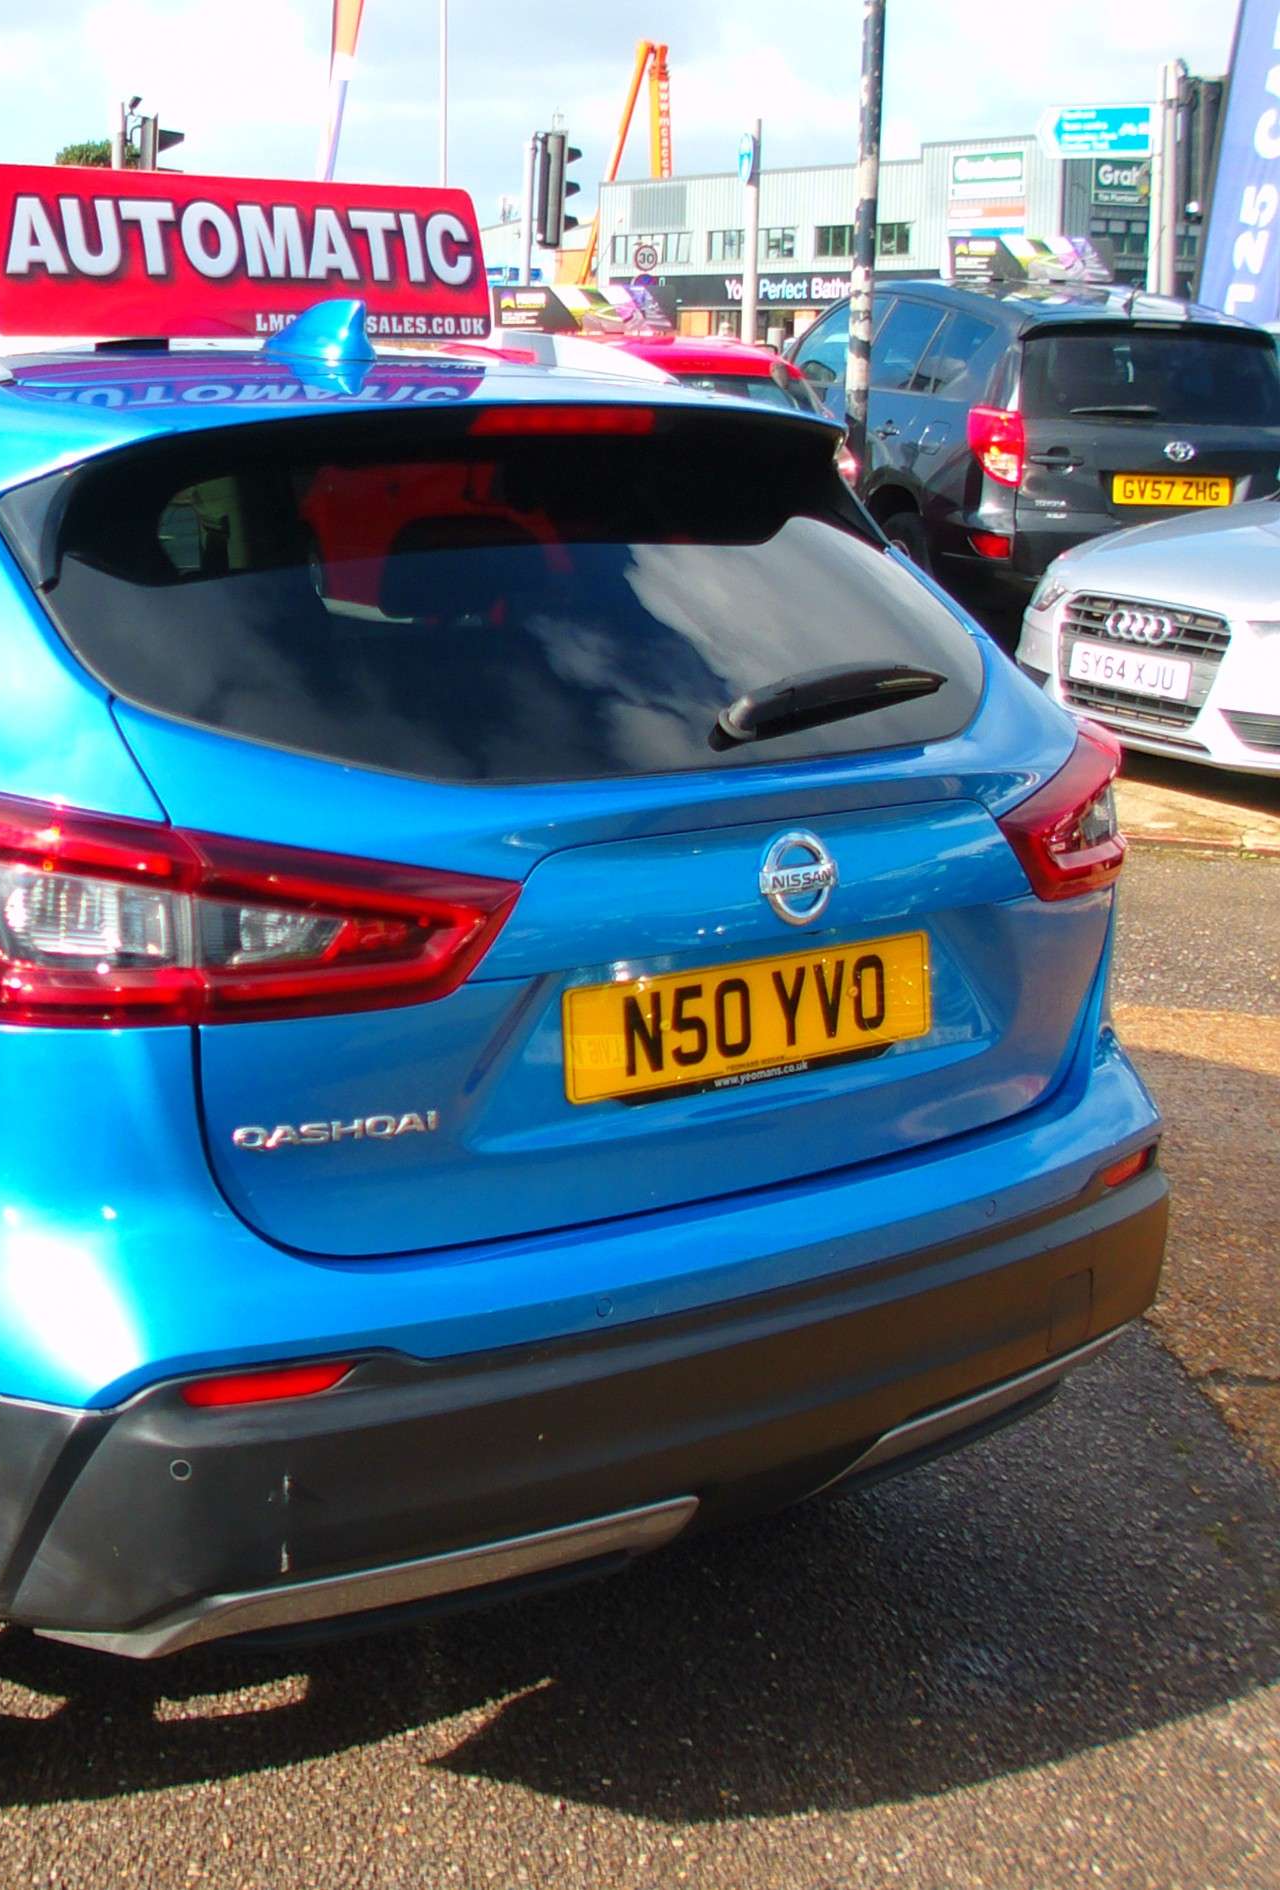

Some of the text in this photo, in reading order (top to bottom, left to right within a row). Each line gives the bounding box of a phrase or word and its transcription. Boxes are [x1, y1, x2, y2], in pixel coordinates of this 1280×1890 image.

[6, 195, 473, 286] AUTOMATIC
[638, 252, 655, 265] 30
[724, 277, 852, 300] Yo Perfect Bathr
[1122, 479, 1220, 501] GV57 ZHG
[1080, 651, 1175, 690] SY64 XJU
[771, 866, 833, 889] NISSAN
[623, 954, 885, 1077] N50 YVO
[714, 1060, 808, 1086] www.yeomans.co.uk
[232, 1110, 437, 1151] QASHQAI
